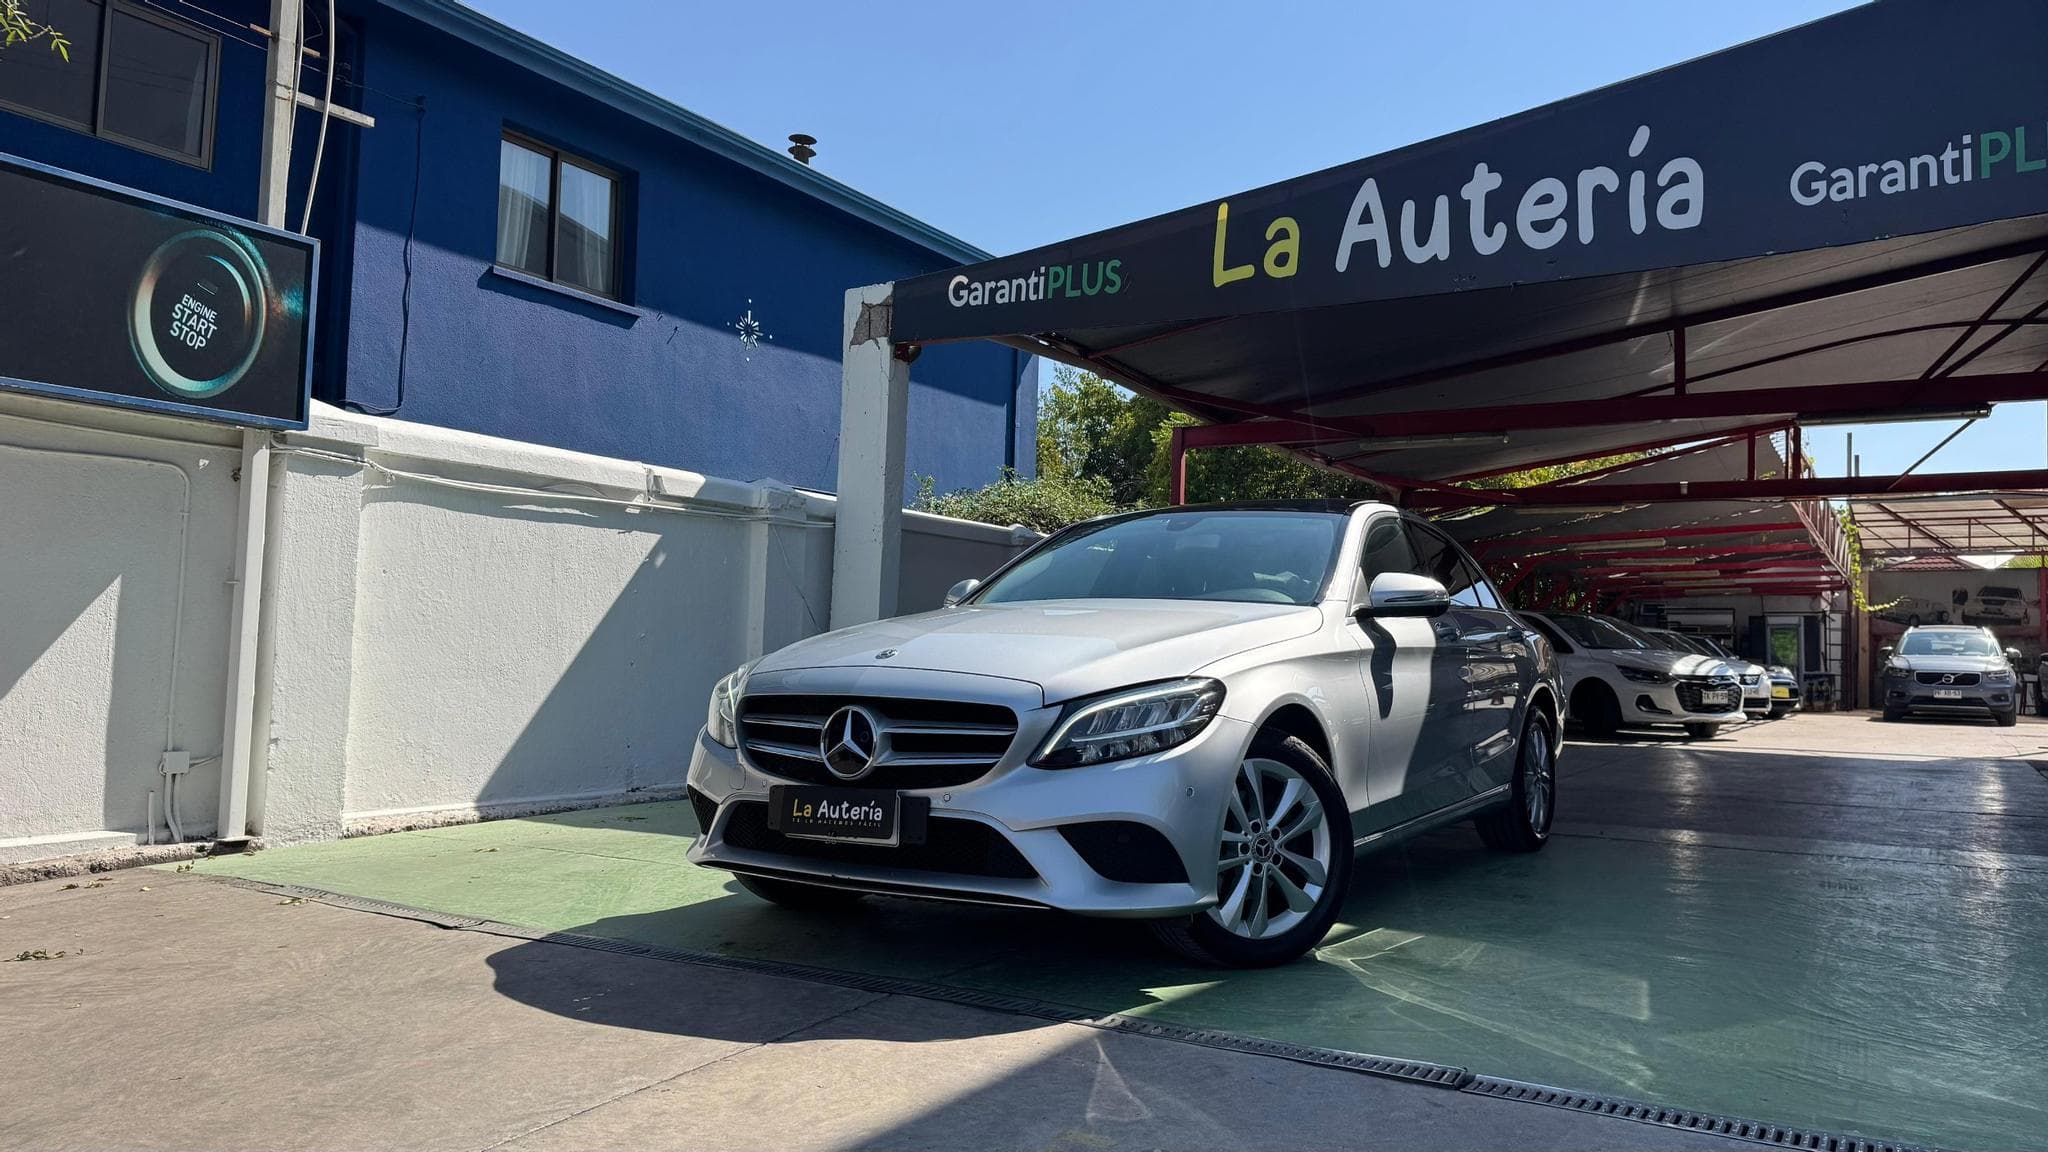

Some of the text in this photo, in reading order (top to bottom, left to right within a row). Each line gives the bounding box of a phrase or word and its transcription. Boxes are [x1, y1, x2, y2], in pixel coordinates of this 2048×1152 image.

[1789, 121, 2048, 207] GarantiPL
[1212, 125, 1704, 287] La Autería
[948, 259, 1122, 308] GarantiPLUS
[171, 303, 217, 339] START
[182, 294, 217, 322] ENGINE
[170, 320, 207, 350] STOP
[792, 798, 883, 821] La Autería
